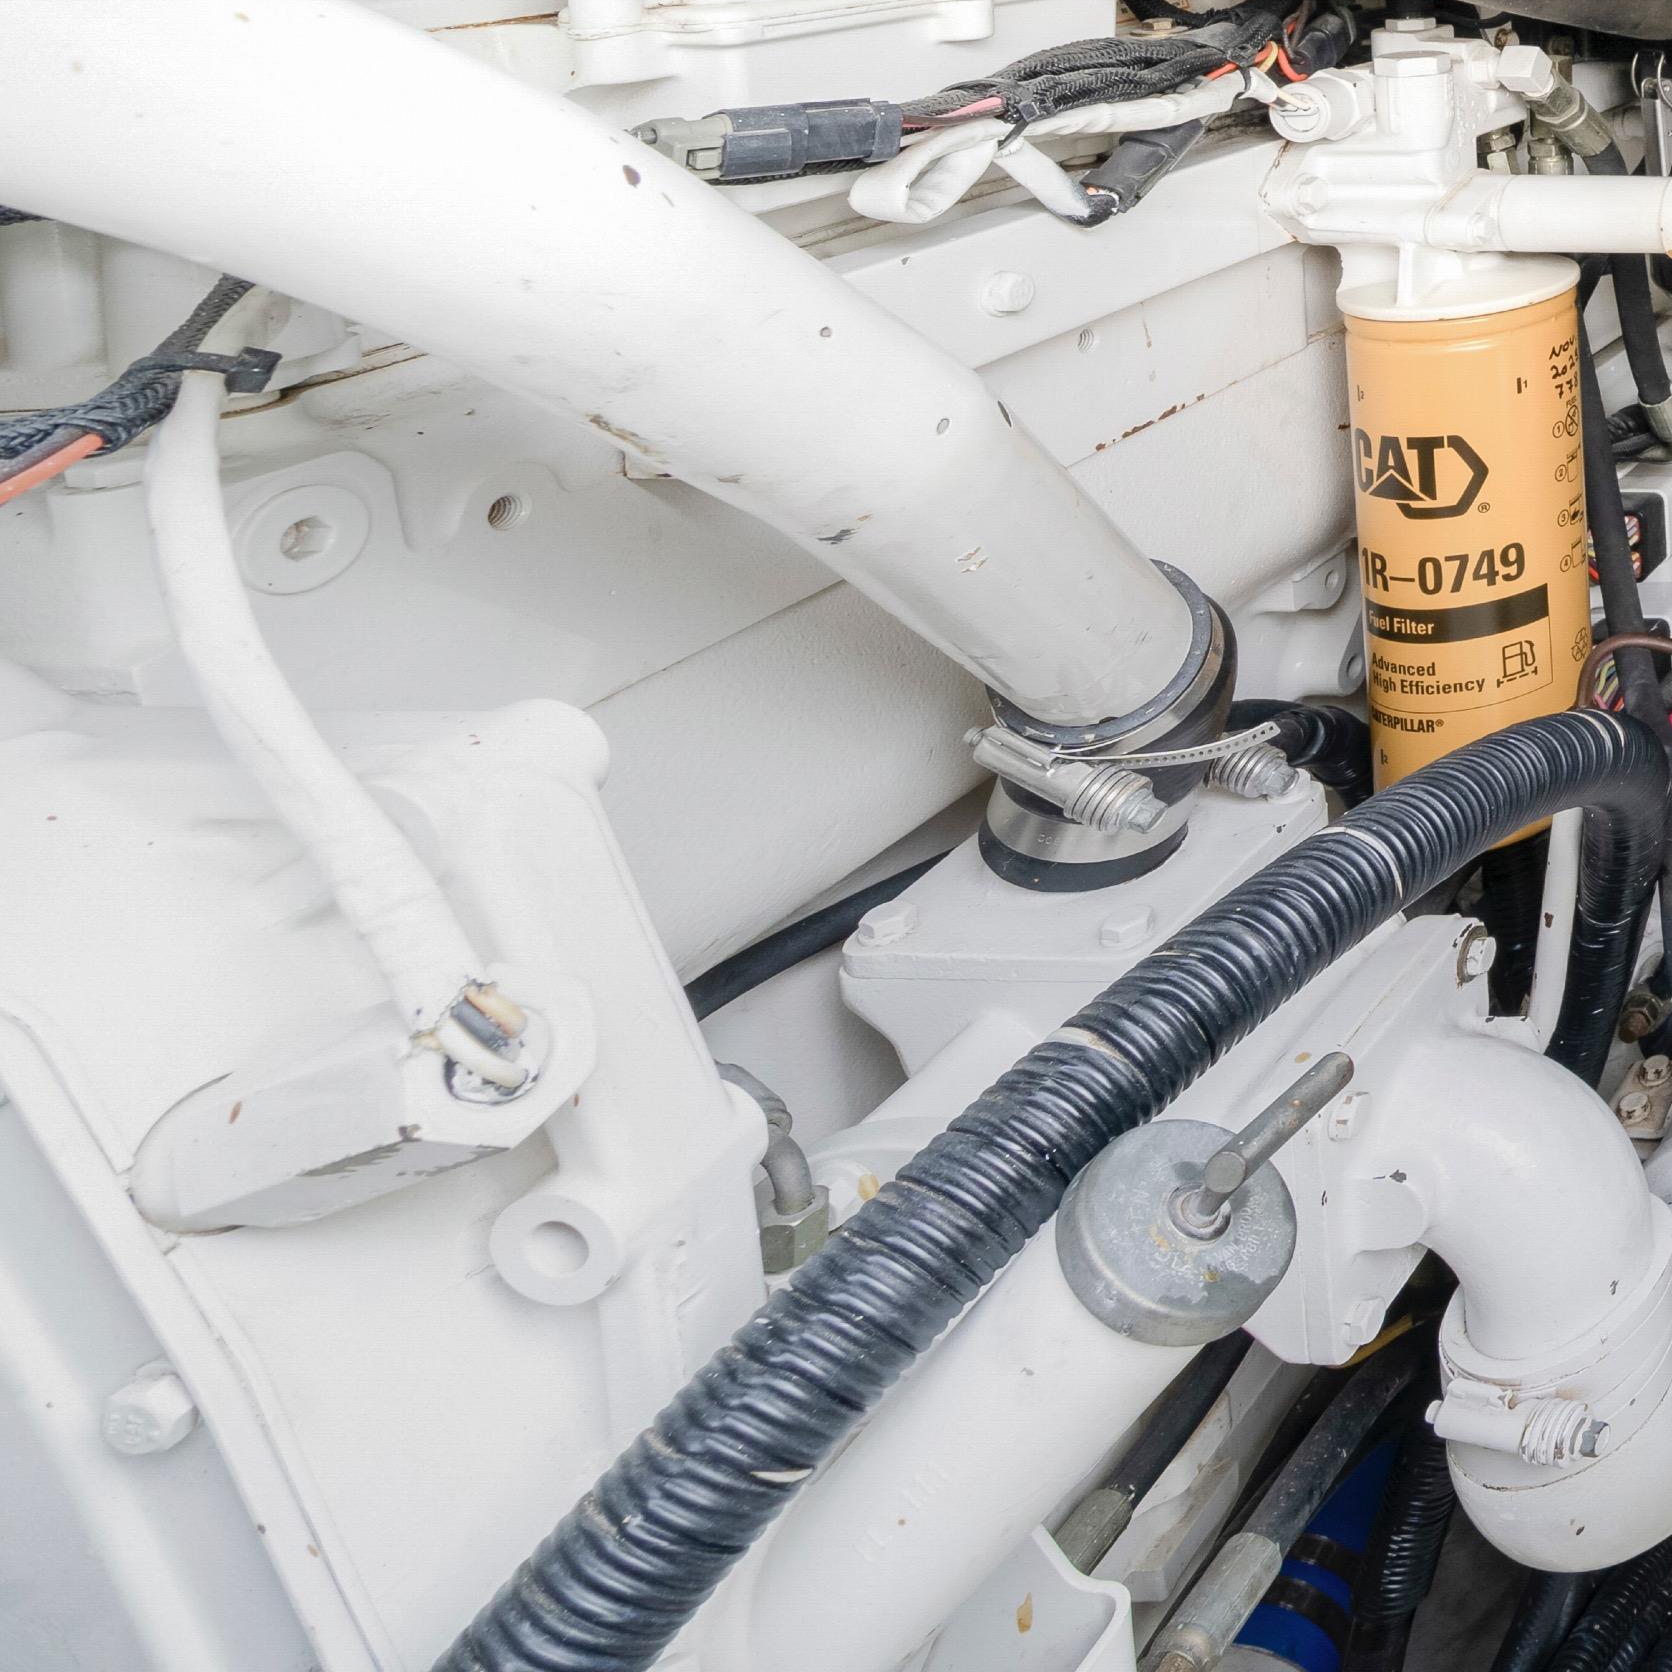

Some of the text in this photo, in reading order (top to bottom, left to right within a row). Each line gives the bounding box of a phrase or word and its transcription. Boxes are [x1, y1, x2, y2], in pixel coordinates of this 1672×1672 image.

[1354, 427, 1437, 501] CAT
[1361, 542, 1526, 596] 1R-0749
[1369, 610, 1435, 636] Fuel Filter
[1372, 652, 1436, 676] Advanced
[1373, 670, 1486, 695] High Efficiency
